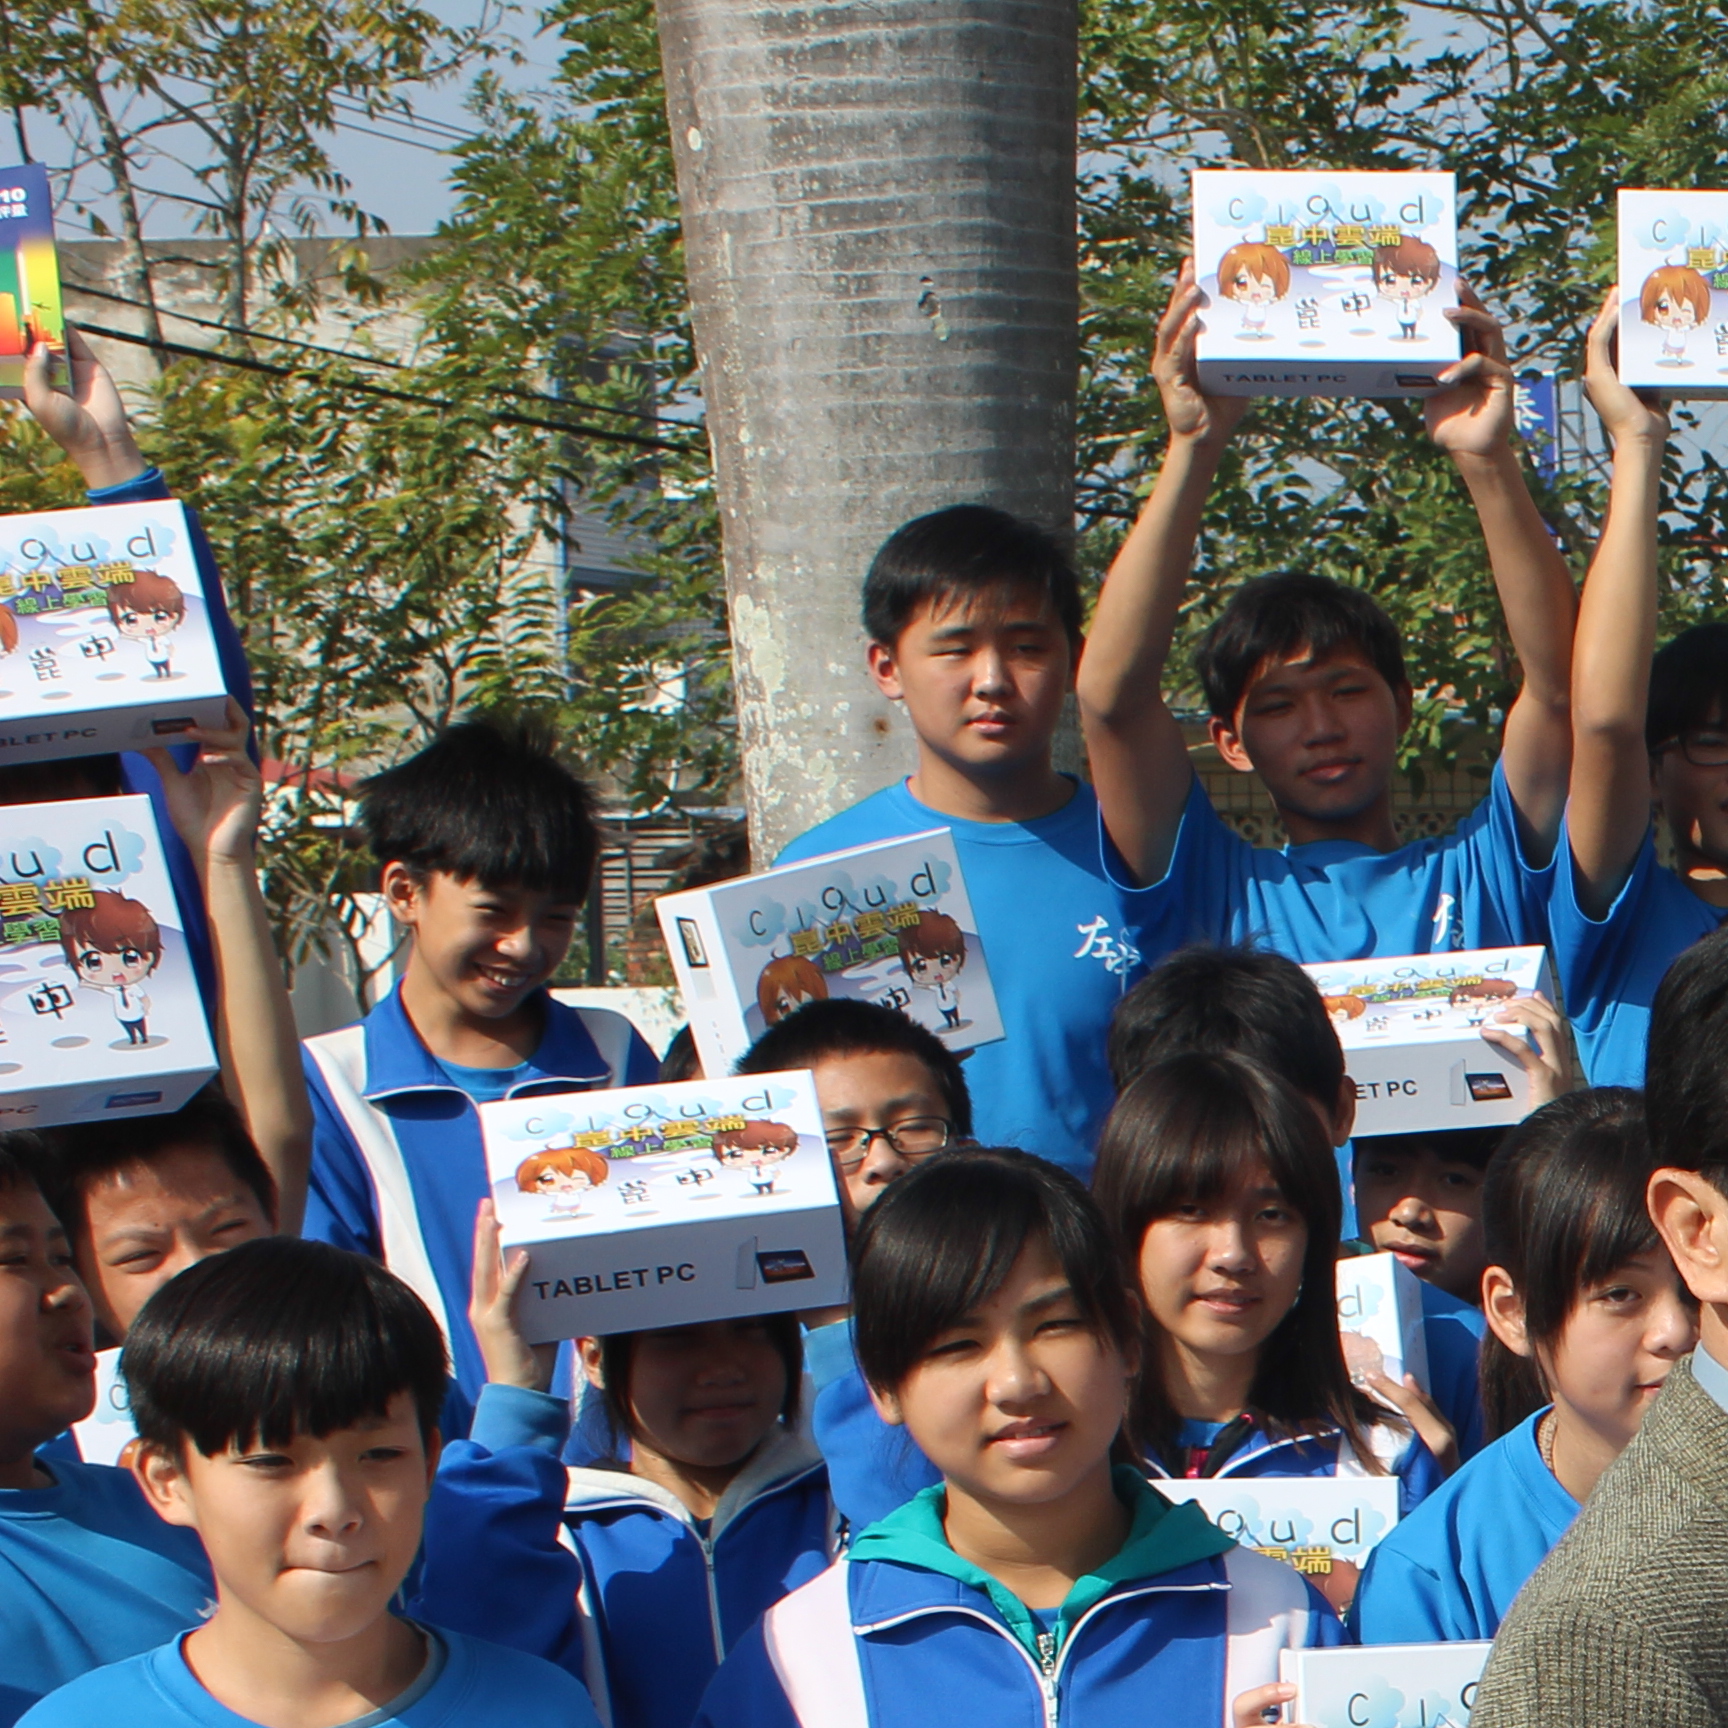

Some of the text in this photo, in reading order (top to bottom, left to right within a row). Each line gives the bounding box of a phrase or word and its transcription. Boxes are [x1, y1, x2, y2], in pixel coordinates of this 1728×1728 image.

[0, 187, 27, 203] 10
[1223, 374, 1347, 383] TABLET PC
[0, 727, 98, 749] BLET PC
[0, 877, 95, 917] 雲端
[1388, 1080, 1418, 1096] PC
[533, 1263, 696, 1300] TABLET PC
